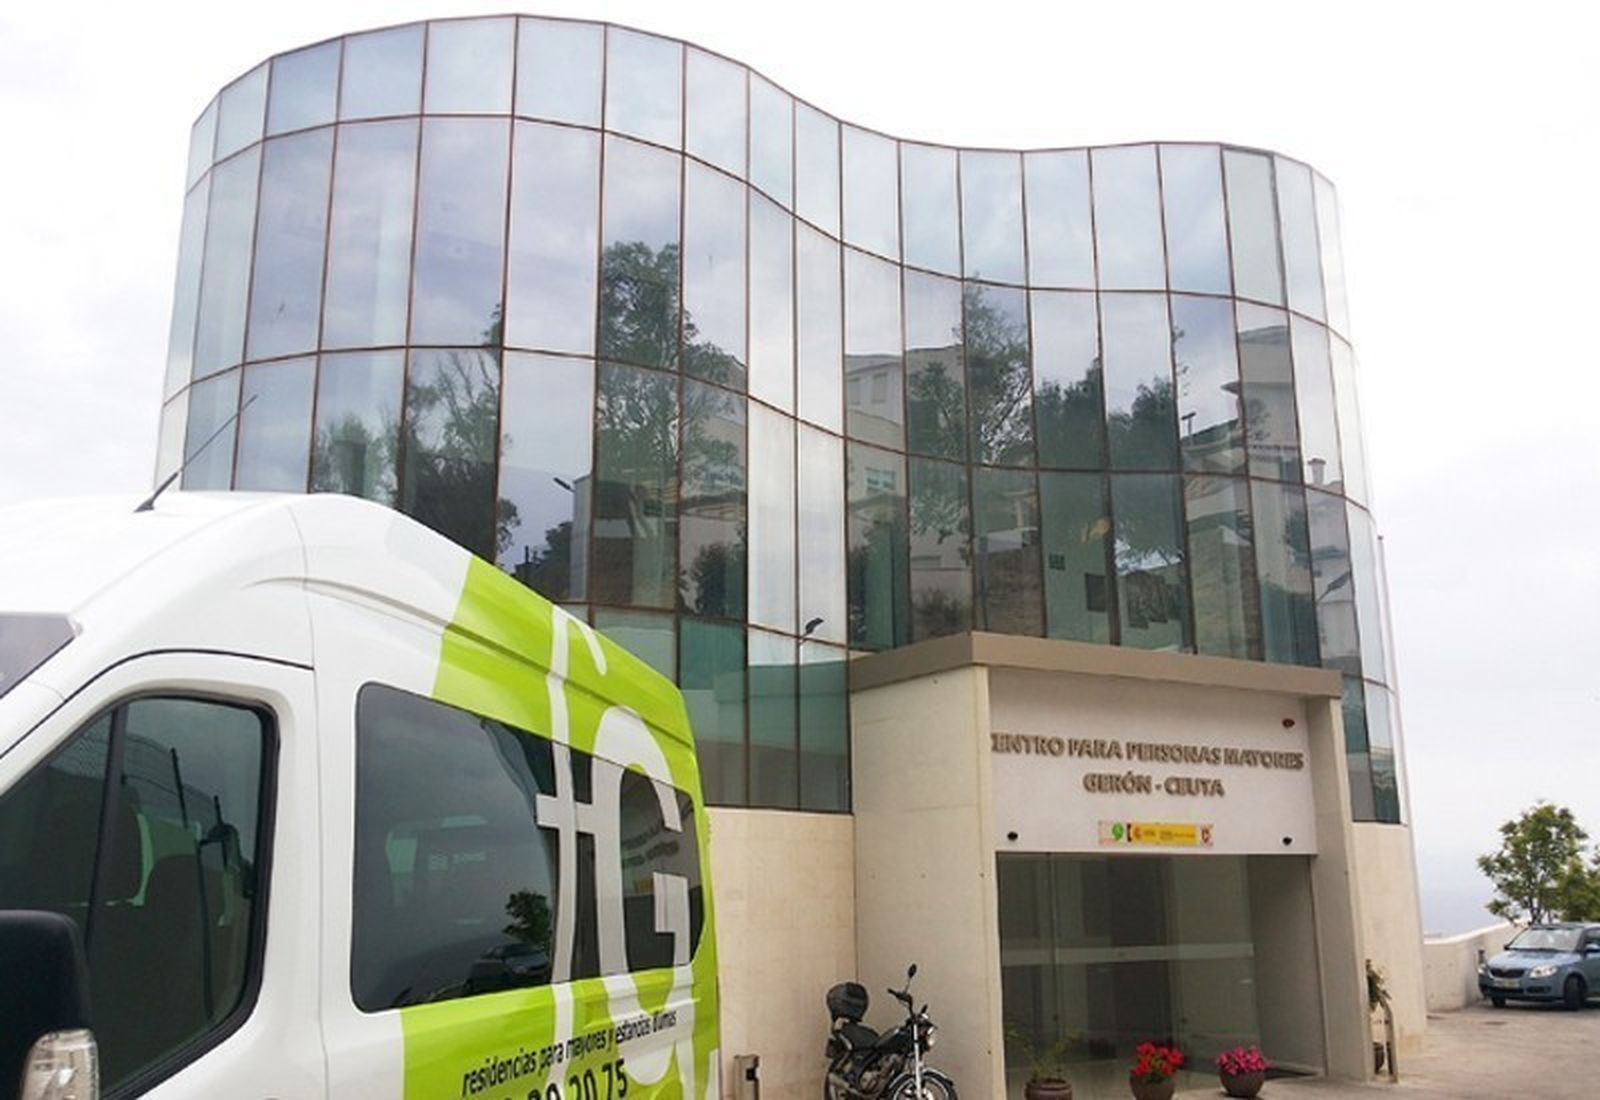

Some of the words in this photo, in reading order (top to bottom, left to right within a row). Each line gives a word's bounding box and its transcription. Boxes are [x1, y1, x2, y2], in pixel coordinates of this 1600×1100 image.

[991, 733, 1064, 756] ENTRO
[1068, 738, 1123, 760] PARA
[1126, 742, 1222, 765] PERSONAS
[1223, 748, 1304, 770] MAYORES
[1083, 771, 1152, 793] GERÓN
[1164, 777, 1225, 797] CEUTA
[462, 1047, 536, 1097] residencias
[539, 1042, 564, 1076] para
[566, 1031, 606, 1060] mayores
[606, 1028, 614, 1052] y
[615, 1014, 651, 1043] estancias
